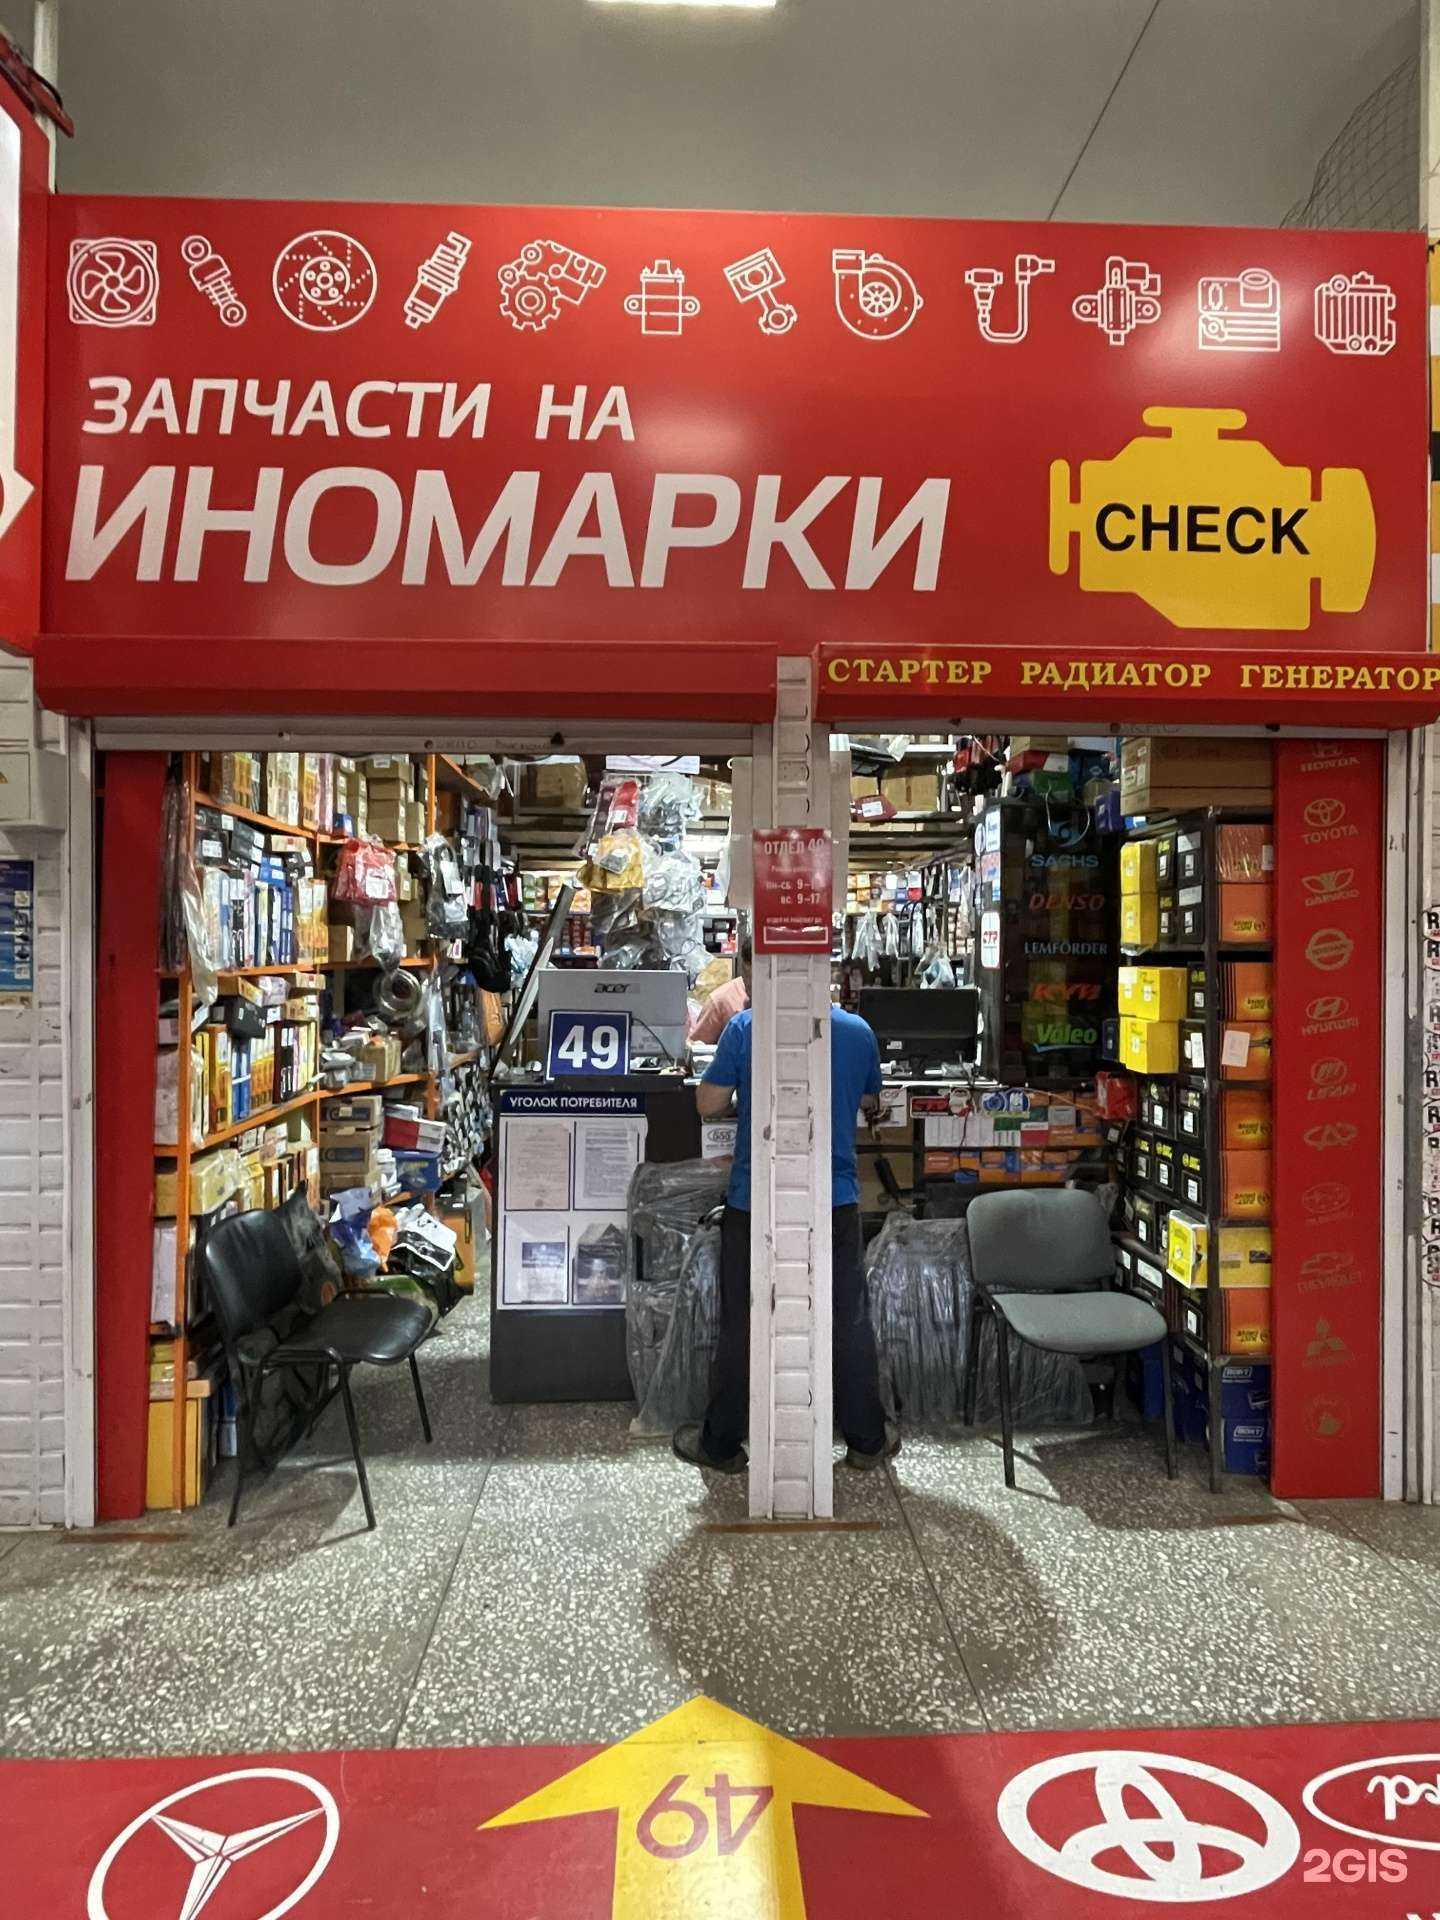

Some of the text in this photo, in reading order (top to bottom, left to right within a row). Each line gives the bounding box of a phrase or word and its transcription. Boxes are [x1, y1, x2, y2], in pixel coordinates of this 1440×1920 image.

[81, 376, 635, 442] ЗАПЧАСТИ НА
[65, 465, 952, 593] ИНОМАРКИ
[1094, 503, 1310, 556] CHECK
[827, 658, 1440, 693] СТАРТЕР РАДИАТОР ГЕНЕРАТОР
[1303, 825, 1359, 844] TOYOTA
[764, 840, 804, 855] ОТДЕЛ
[1031, 855, 1098, 867] SACHS
[1029, 895, 1104, 910] DENSO
[594, 982, 631, 994] acer
[1037, 1023, 1097, 1043] Valeo
[557, 1025, 618, 1070] 49
[509, 1096, 637, 1109] УГОЛОК ПОТРЕБИТЕЛЯ
[636, 1772, 775, 1860] 49
